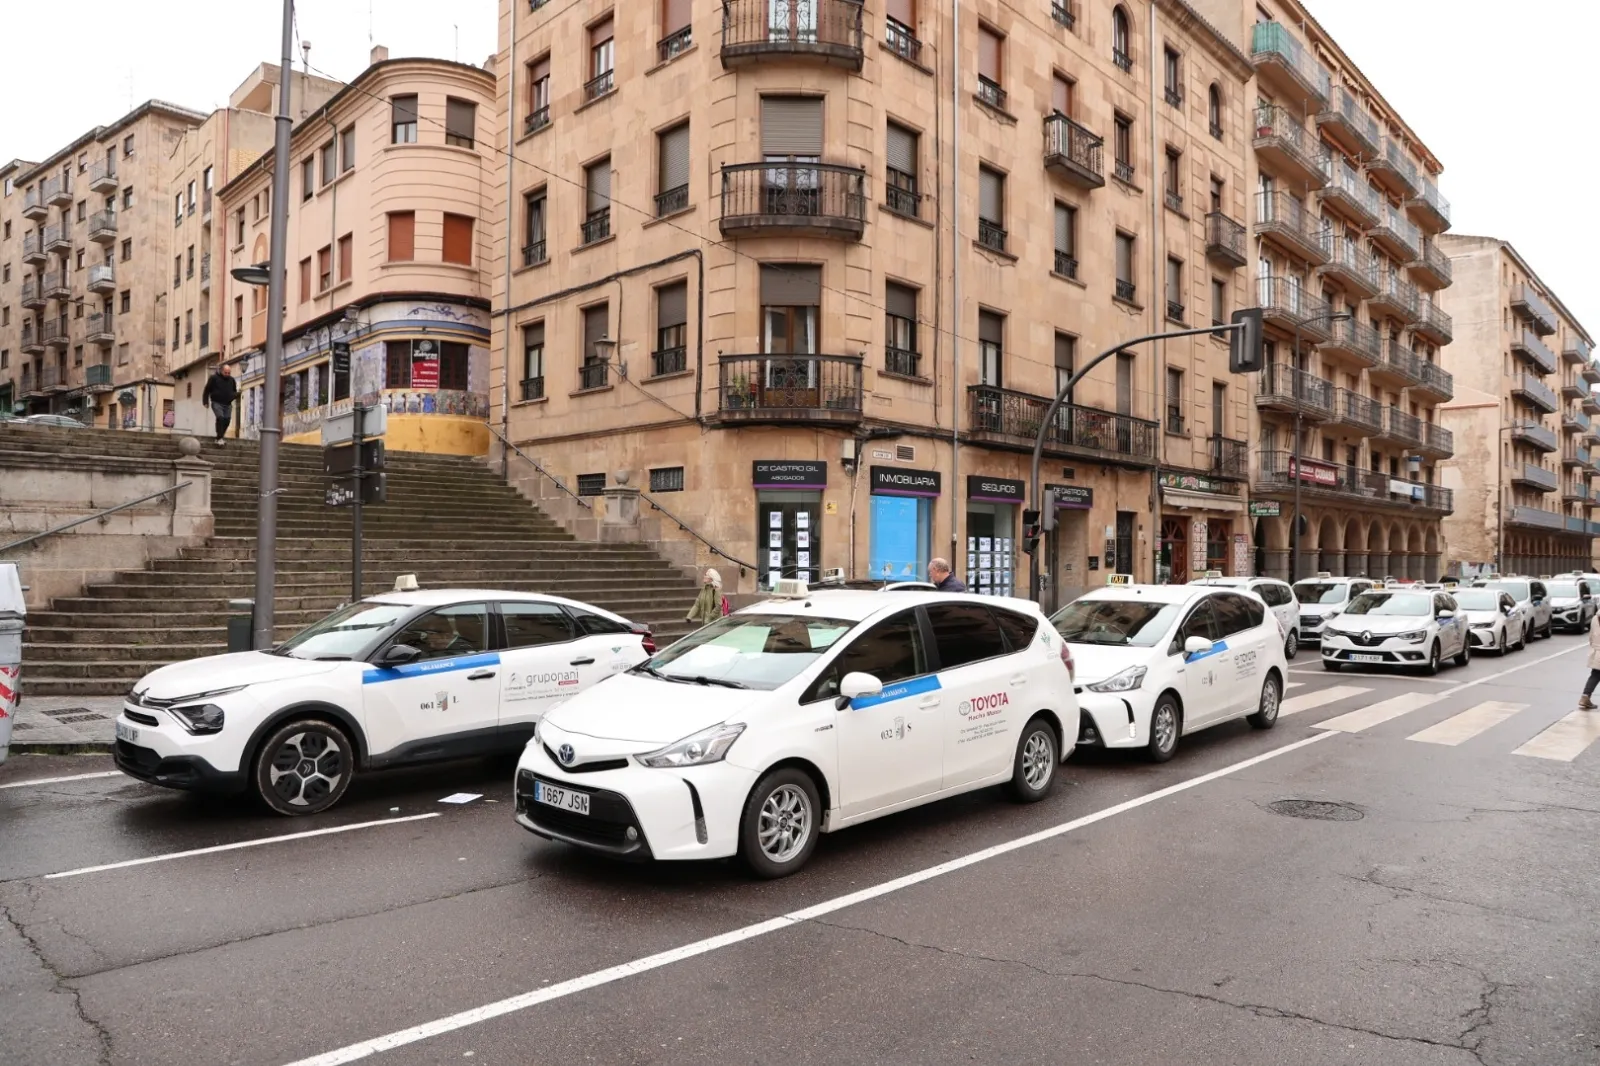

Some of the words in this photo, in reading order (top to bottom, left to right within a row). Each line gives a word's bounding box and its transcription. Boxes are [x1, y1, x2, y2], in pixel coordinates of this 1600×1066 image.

[879, 473, 936, 487] INMOBILIARIA
[981, 482, 1016, 494] SEGUROS
[1061, 487, 1081, 496] CASTRO
[1112, 575, 1125, 584] TAXI
[525, 667, 579, 687] gruponani
[420, 701, 435, 710] 061
[970, 692, 1009, 712] TOYOTA
[880, 729, 893, 740] 032
[542, 786, 565, 805] 1667
[567, 793, 588, 812] JSN
